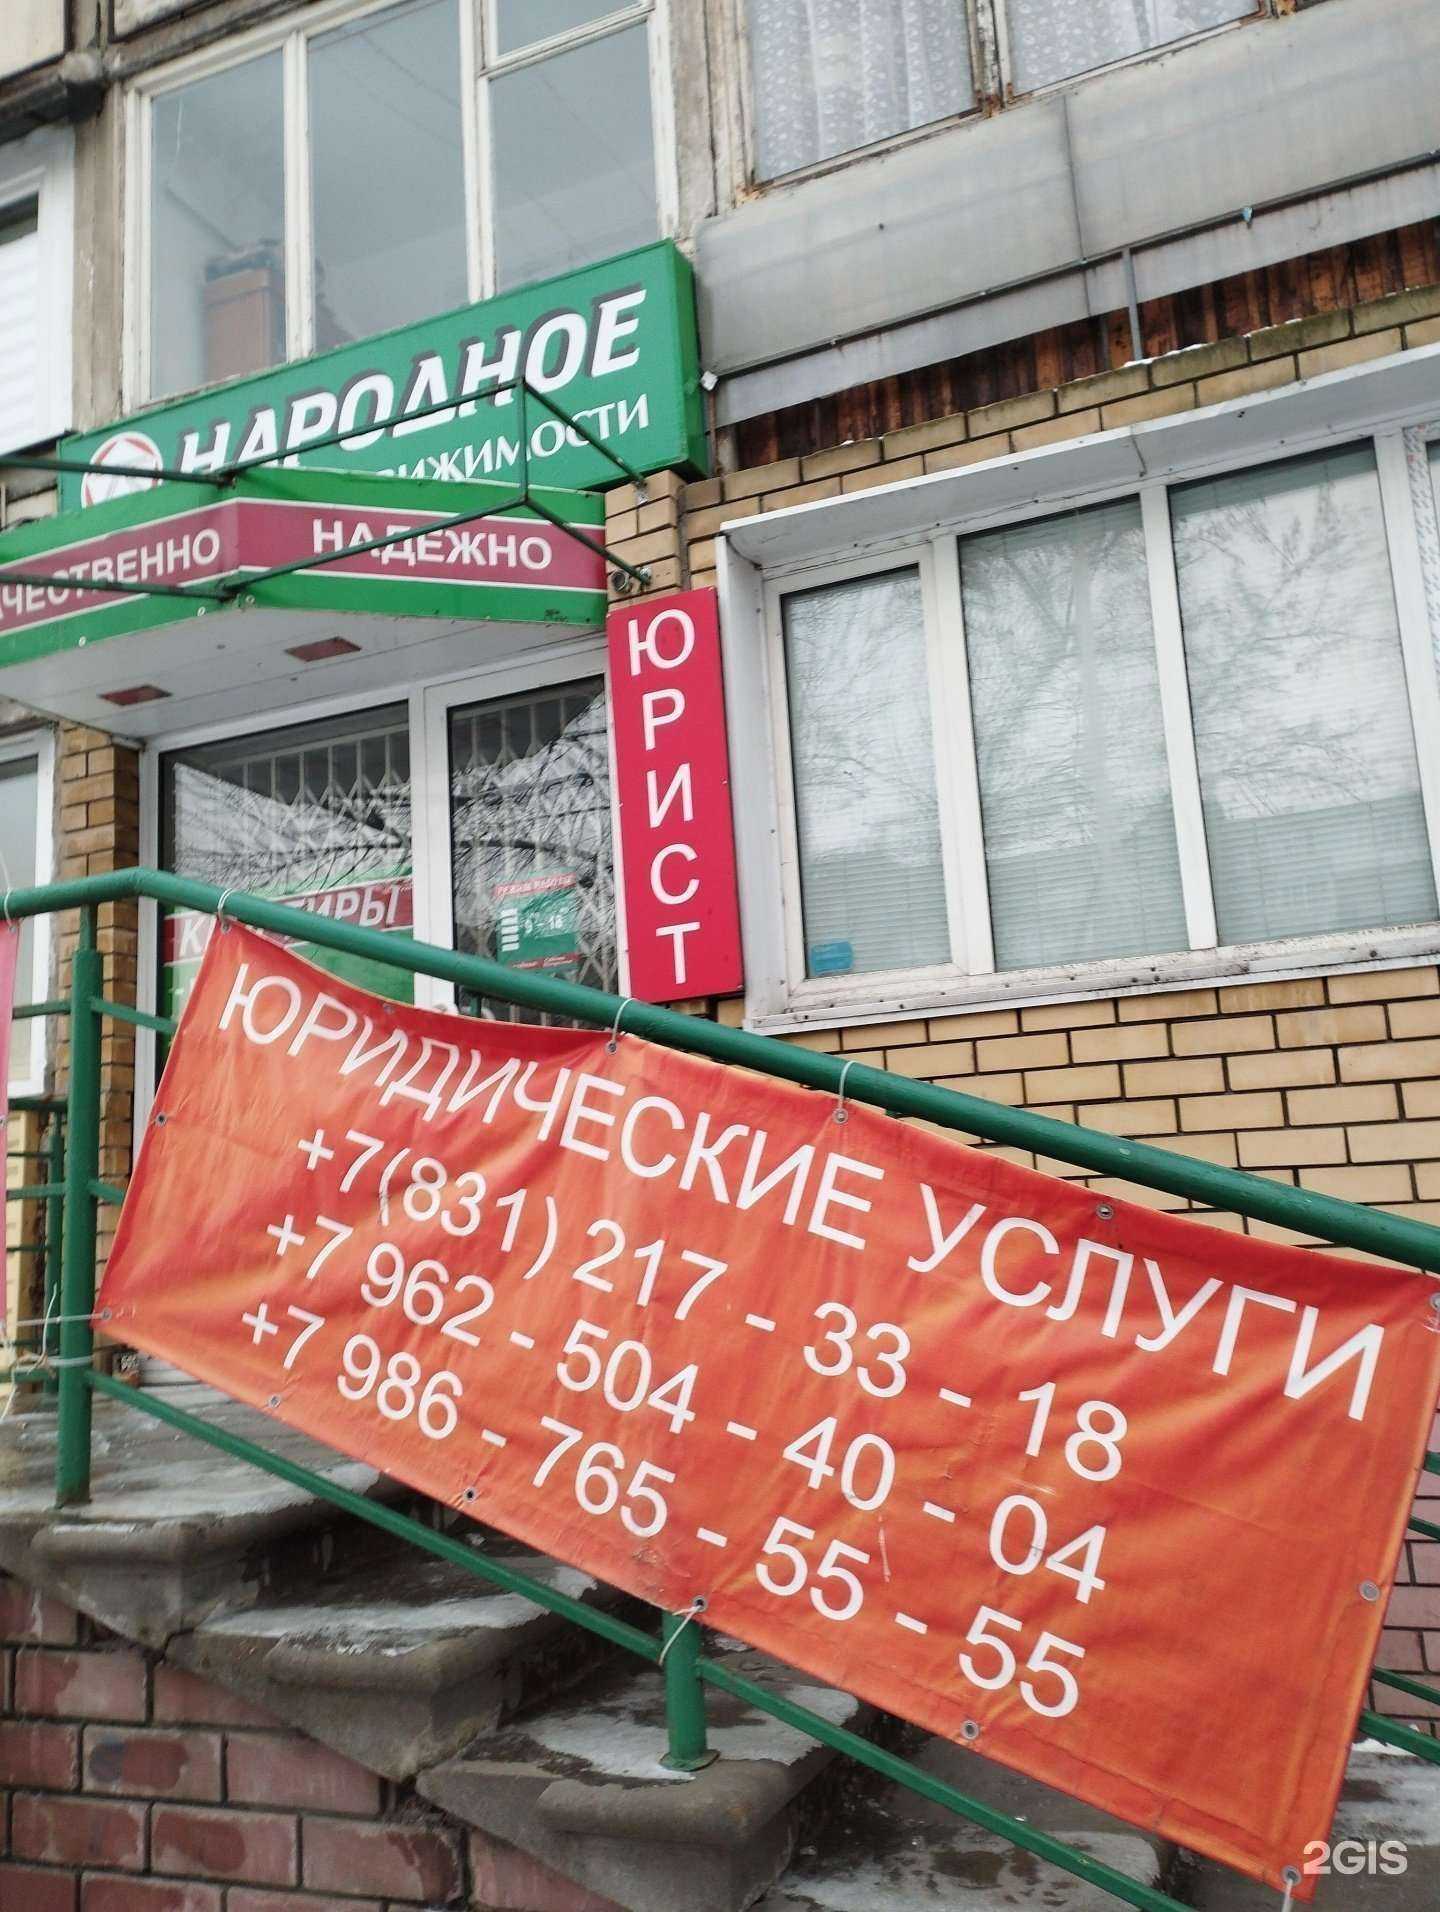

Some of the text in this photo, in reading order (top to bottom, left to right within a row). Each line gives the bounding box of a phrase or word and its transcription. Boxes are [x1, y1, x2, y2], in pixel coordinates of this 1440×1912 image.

[0, 528, 220, 621] ЧЕСТВЕННО
[312, 519, 553, 571] НАДЕЖНО
[628, 608, 701, 985] ЮРИСТ
[219, 963, 1385, 1421] ЮРИДИЧЕСКИЕ УСЛУГИ
[572, 1219, 728, 1321] 217
[803, 1302, 911, 1398] 33
[1018, 1381, 1128, 1482] 18
[242, 1303, 325, 1370] +7
[337, 1334, 463, 1440] 986
[532, 1415, 676, 1538] 765
[756, 1516, 870, 1621] 55
[959, 1605, 1085, 1718] 55
[266, 1214, 354, 1280] +7
[360, 1242, 495, 1347] 962
[556, 1319, 699, 1434] 504
[783, 1416, 896, 1511] 40
[989, 1494, 1107, 1604] 04
